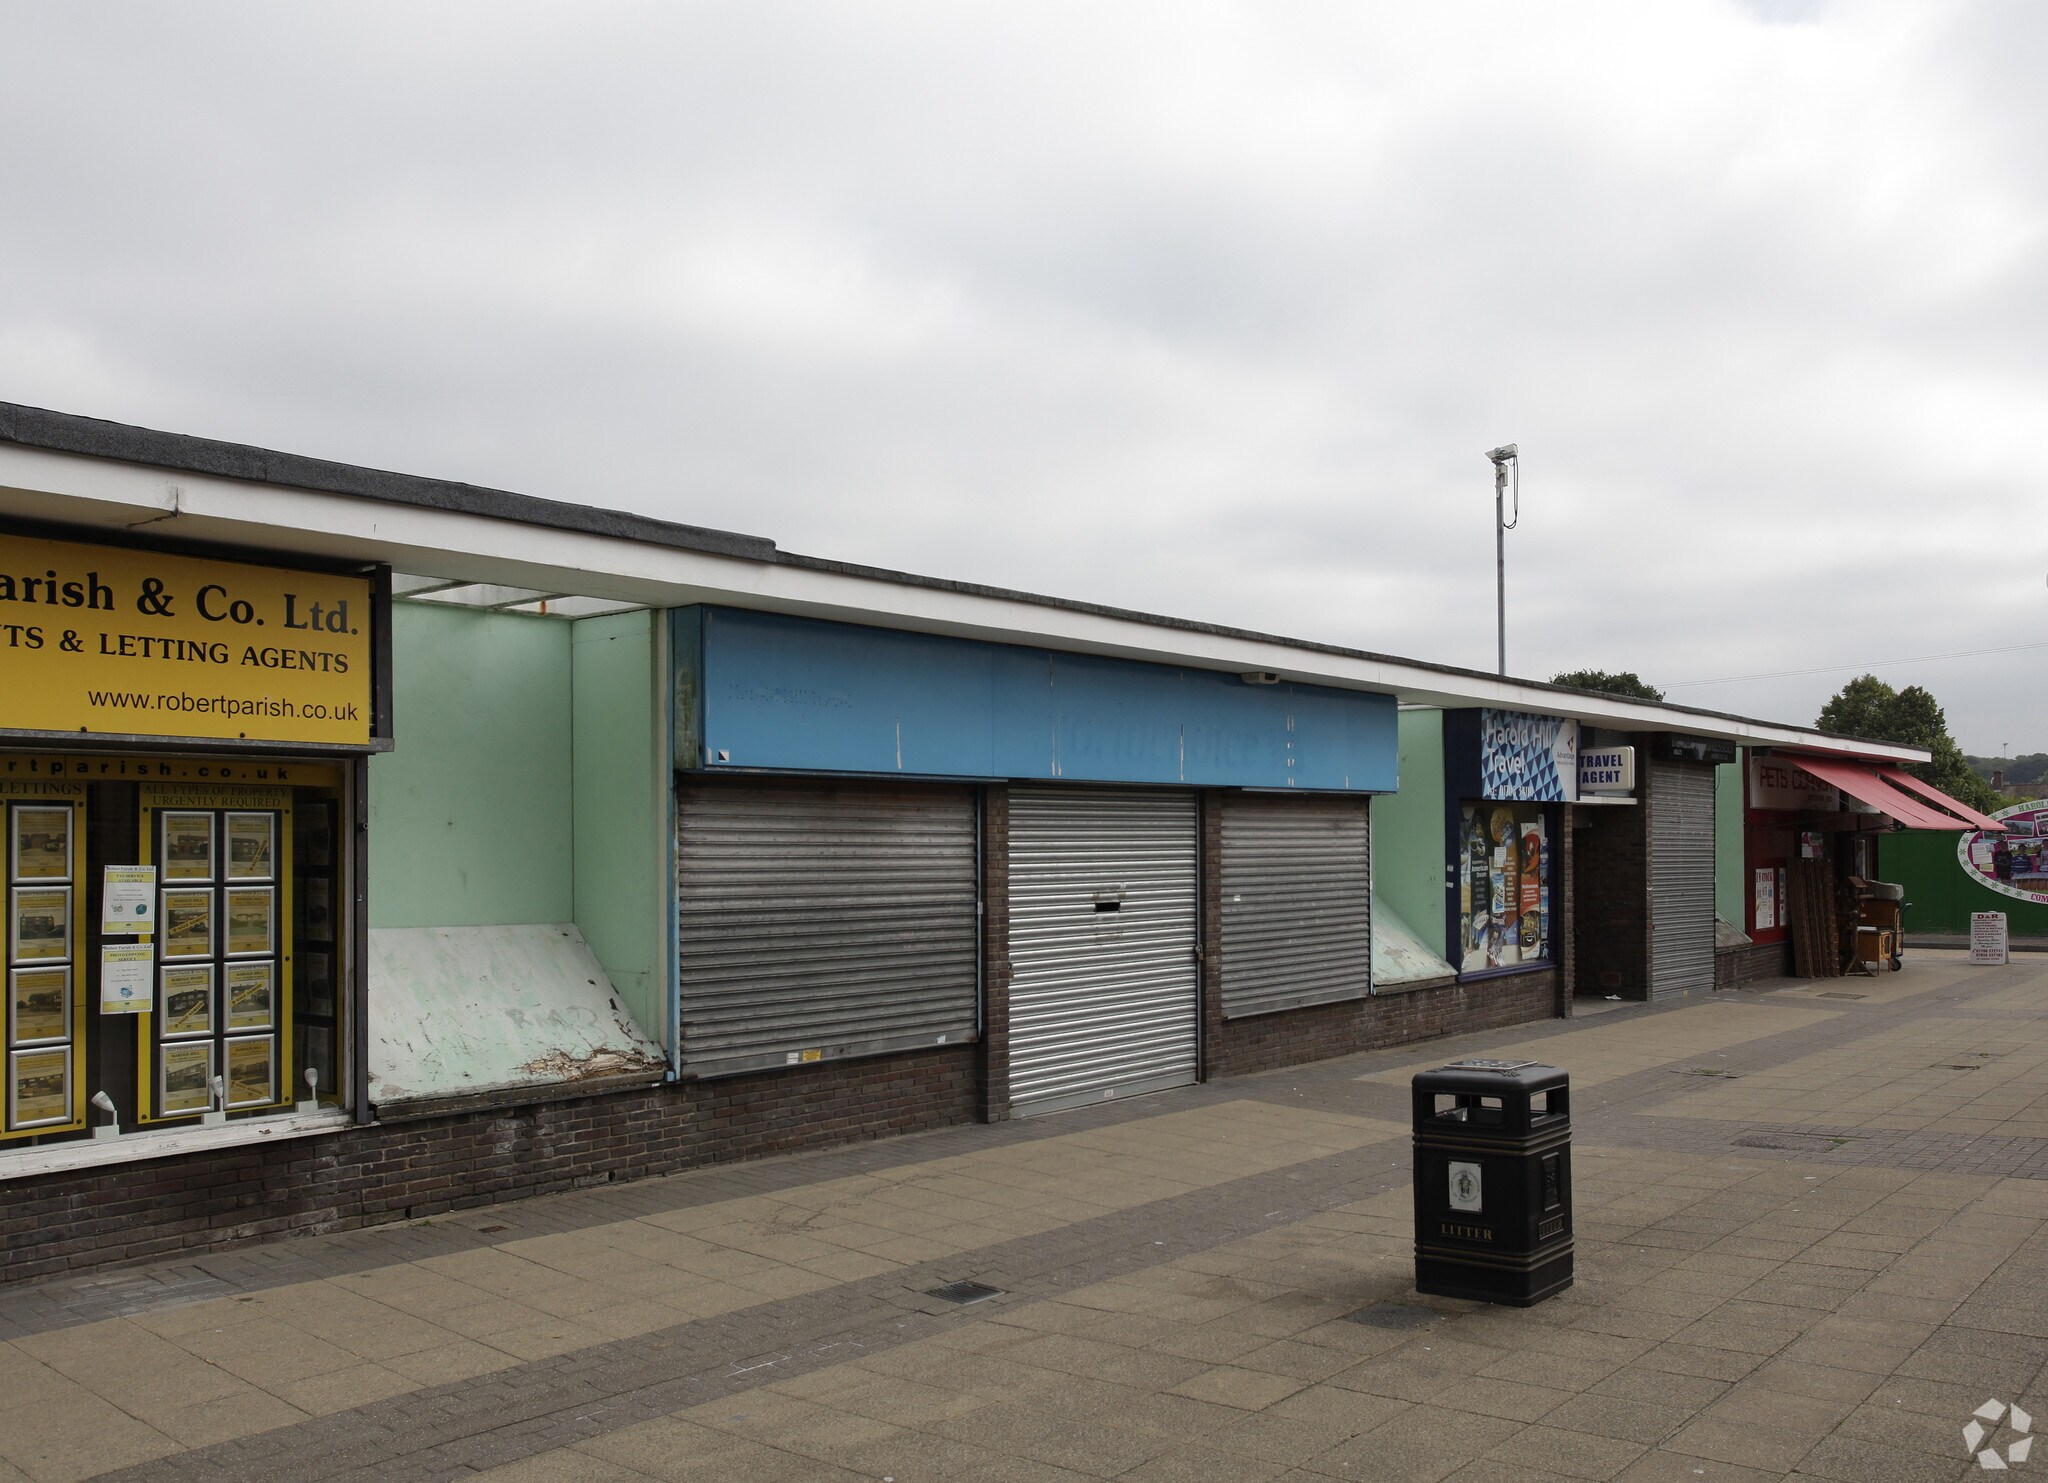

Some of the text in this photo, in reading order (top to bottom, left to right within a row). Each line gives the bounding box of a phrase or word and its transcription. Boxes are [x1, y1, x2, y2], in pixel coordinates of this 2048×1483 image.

[136, 577, 175, 617] &
[196, 584, 264, 626] Co.
[283, 593, 359, 635] Ltd.
[0, 624, 349, 674] TS & LETTING AGENTS
[88, 690, 359, 721] www.robertparish.co.uk
[1486, 719, 1552, 749] Harold Hill
[1488, 748, 1525, 774] Travel
[1580, 754, 1623, 768] TRAVEL
[1582, 771, 1621, 784] AGENT
[1760, 766, 1788, 789] PETS
[144, 785, 288, 797] ALL TYPES OF PROPERTY
[152, 796, 281, 808] URGENTLY REQUIRED
[1440, 1223, 1493, 1240] LITTER
